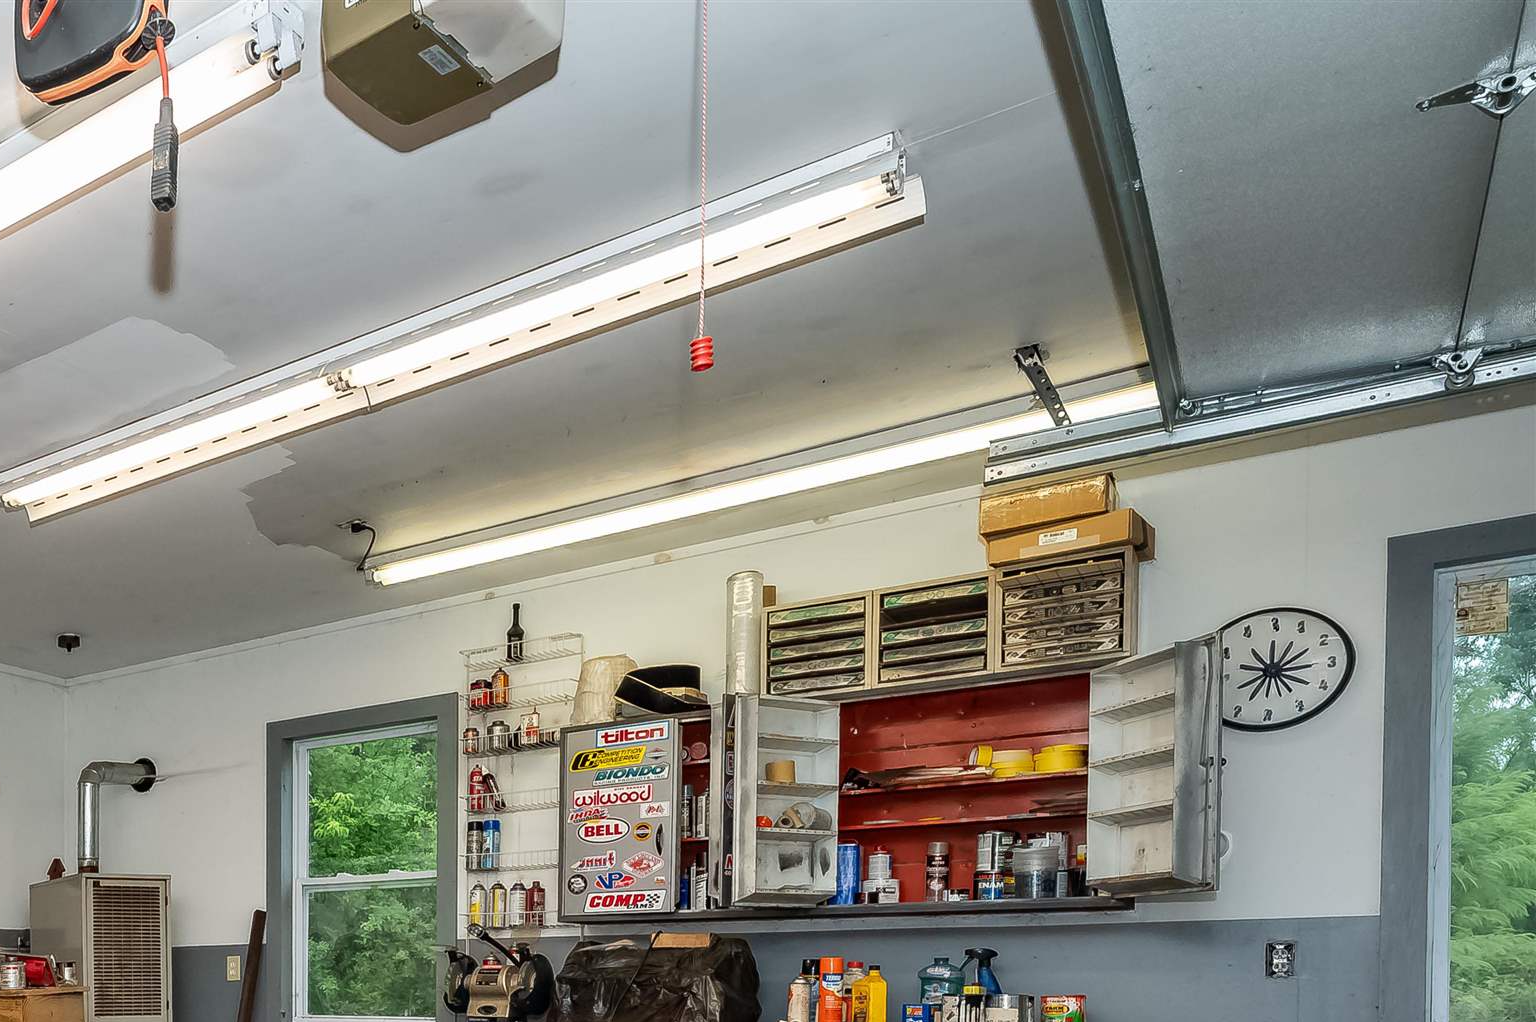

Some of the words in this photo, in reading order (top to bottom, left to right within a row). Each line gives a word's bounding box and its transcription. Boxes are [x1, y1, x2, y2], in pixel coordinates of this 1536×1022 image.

[600, 726, 665, 745] tilton
[593, 754, 641, 767] ENGINEERING
[596, 747, 644, 760] COMPETITION
[594, 765, 667, 782] BIONDO
[574, 784, 652, 808] wilwood
[584, 823, 623, 838] BELL
[589, 893, 647, 909] COMP
